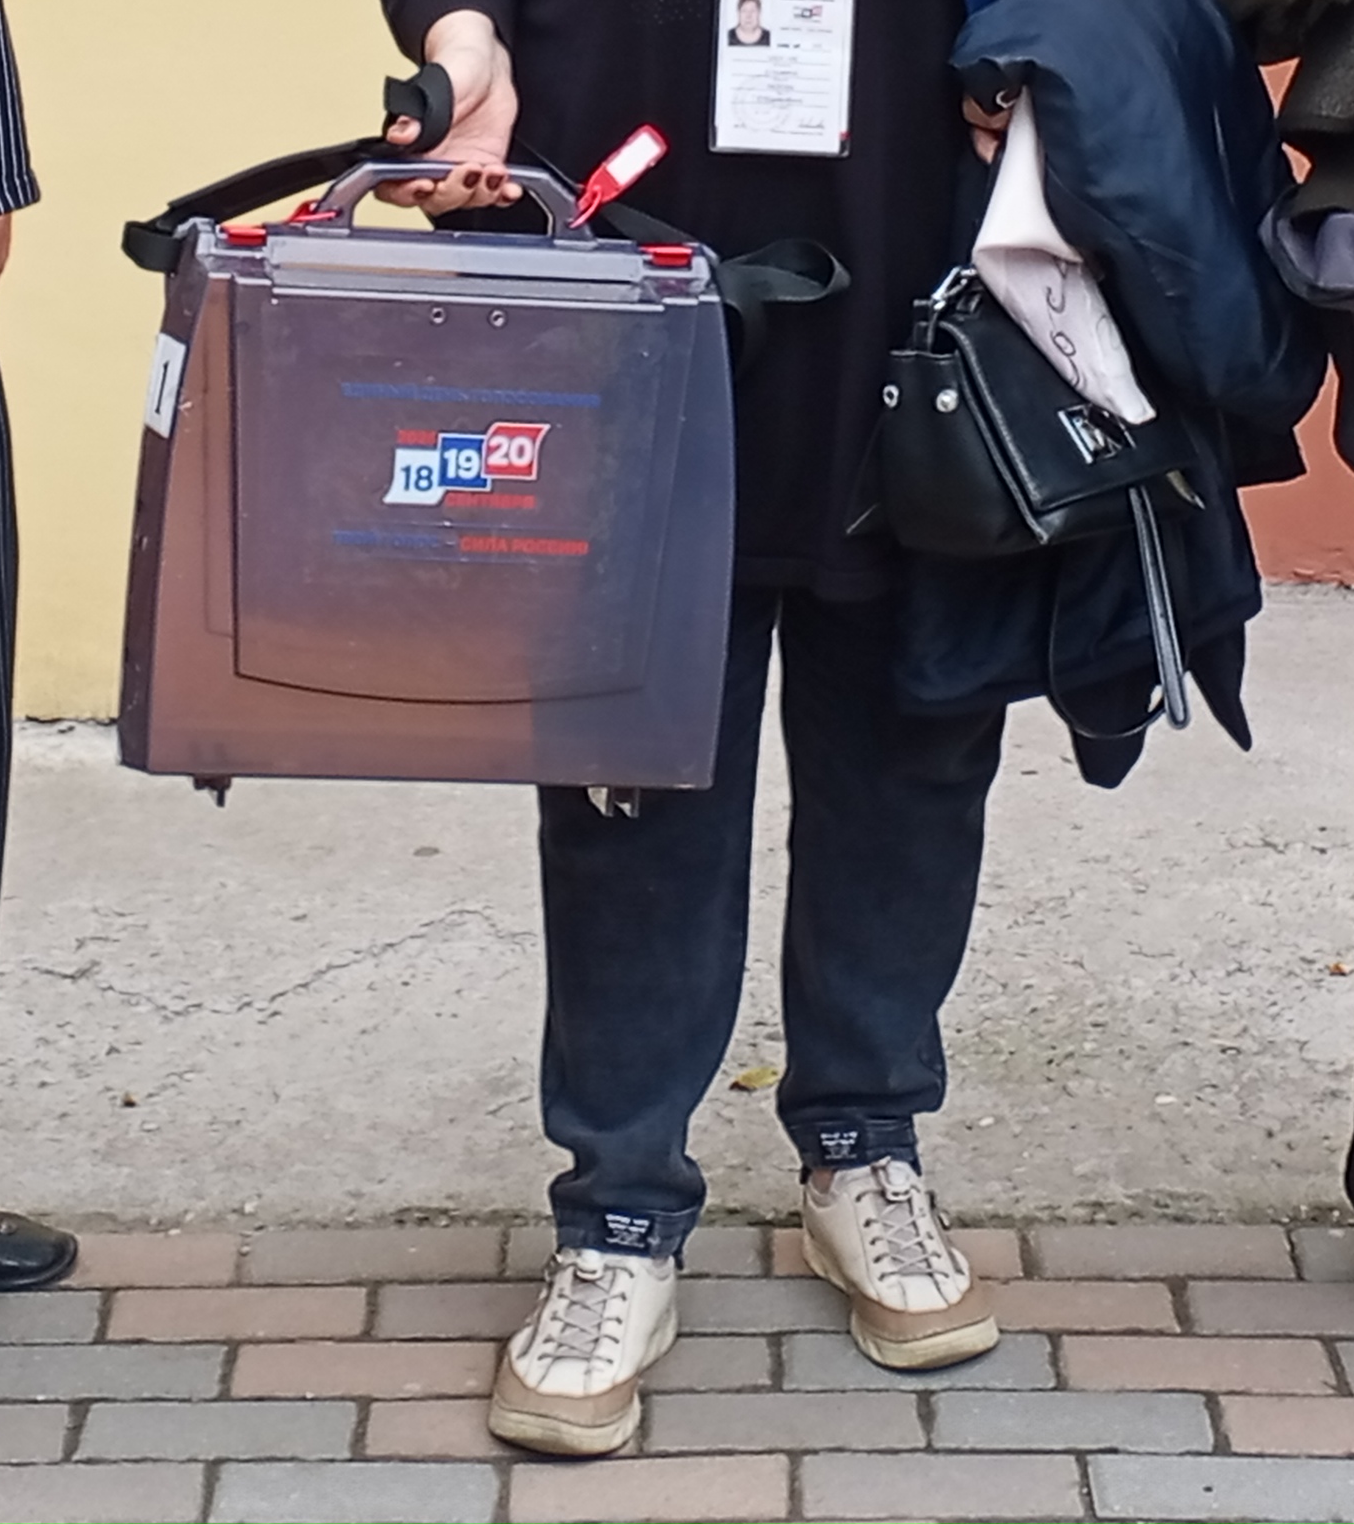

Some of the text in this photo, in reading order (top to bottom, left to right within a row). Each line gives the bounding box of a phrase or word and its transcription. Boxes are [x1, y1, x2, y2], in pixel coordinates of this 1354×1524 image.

[400, 435, 535, 492] 18 19 20
